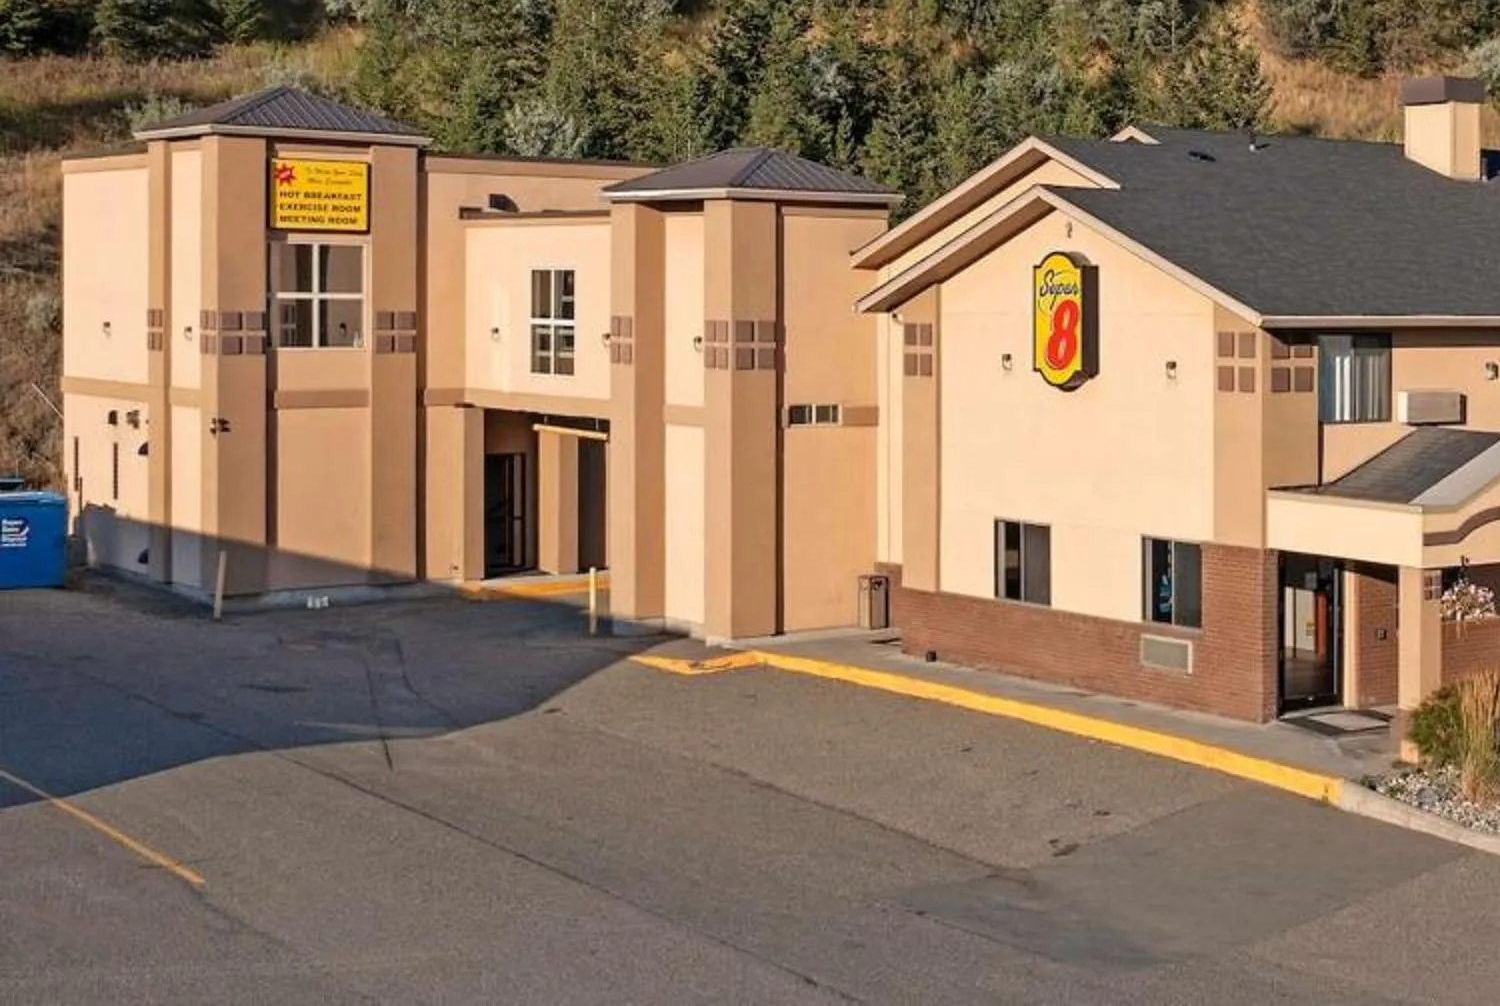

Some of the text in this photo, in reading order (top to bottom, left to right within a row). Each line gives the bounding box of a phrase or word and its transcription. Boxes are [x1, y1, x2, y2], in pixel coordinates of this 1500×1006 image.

[279, 191, 361, 200] HOT BREAKFAST
[279, 202, 361, 213] EXERCISE ROOM
[279, 215, 358, 225] MEETING ROOM
[1039, 269, 1079, 310] Super
[1045, 298, 1080, 371] 8
